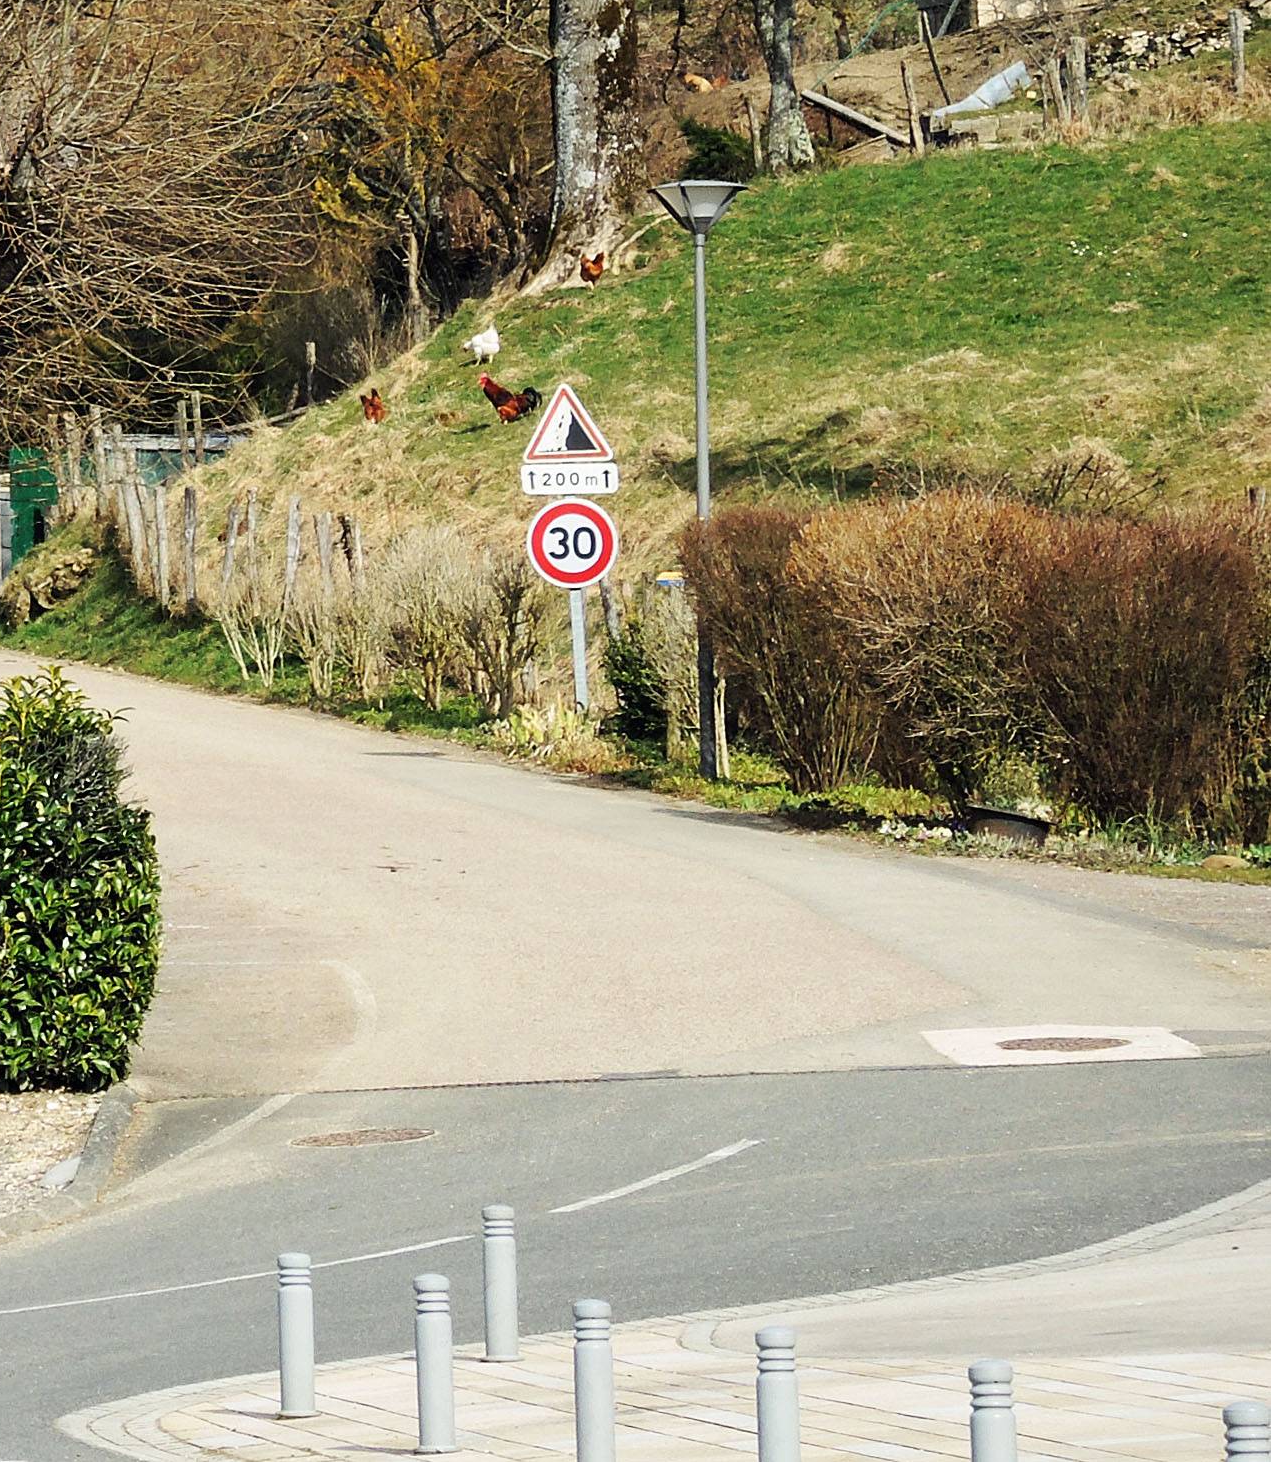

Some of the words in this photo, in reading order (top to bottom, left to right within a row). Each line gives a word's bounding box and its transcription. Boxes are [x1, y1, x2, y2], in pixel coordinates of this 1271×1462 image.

[541, 472, 580, 487] 200
[585, 475, 598, 487] m
[548, 526, 597, 560] 30
